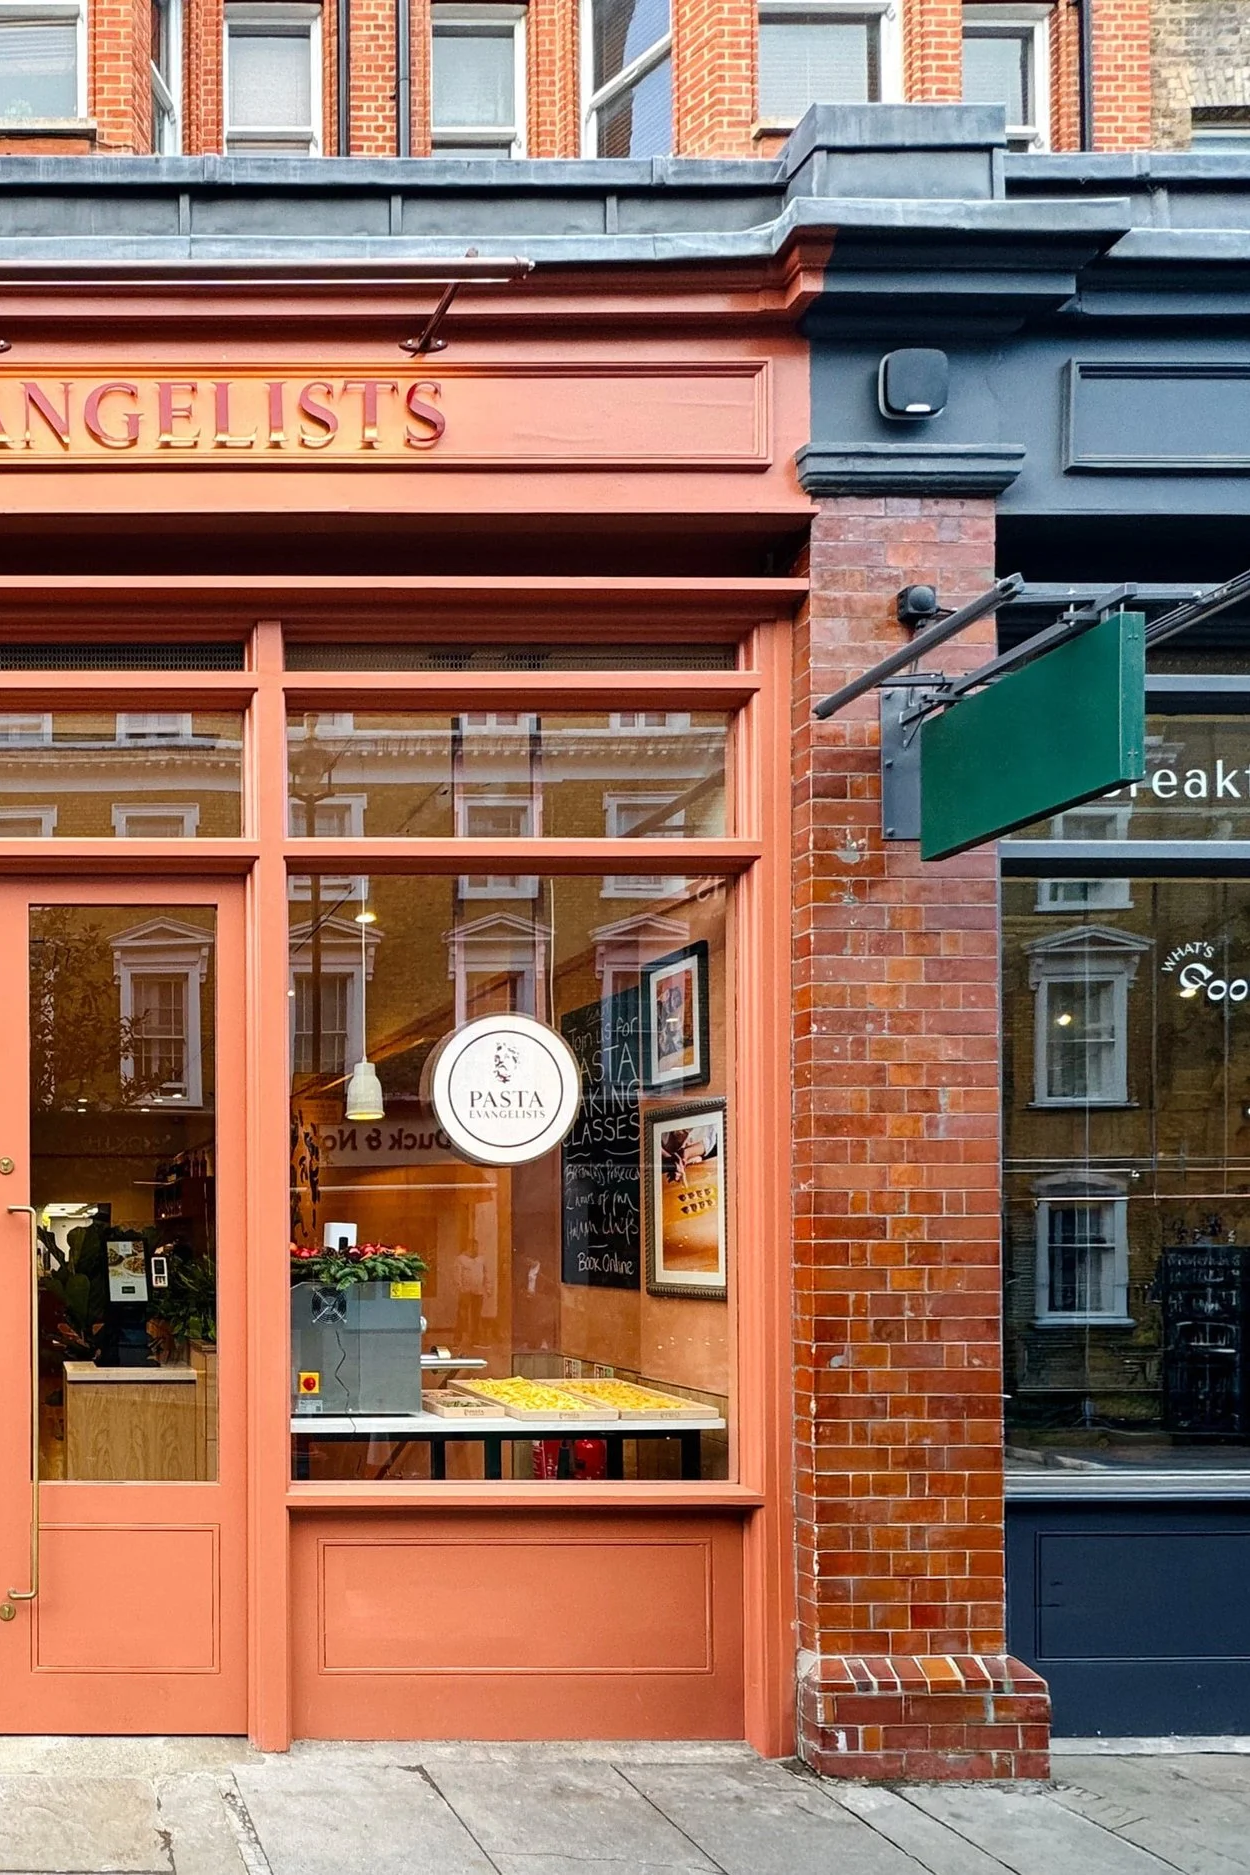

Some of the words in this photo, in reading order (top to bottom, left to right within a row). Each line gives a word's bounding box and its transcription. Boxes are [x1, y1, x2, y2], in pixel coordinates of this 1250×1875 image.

[1161, 941, 1215, 972] WHAT'S
[580, 1042, 639, 1085] ASTA
[470, 1090, 544, 1108] PASTA
[469, 1110, 546, 1119] EVANGELISTS
[577, 1252, 602, 1272] Book
[602, 1252, 635, 1276] Online
